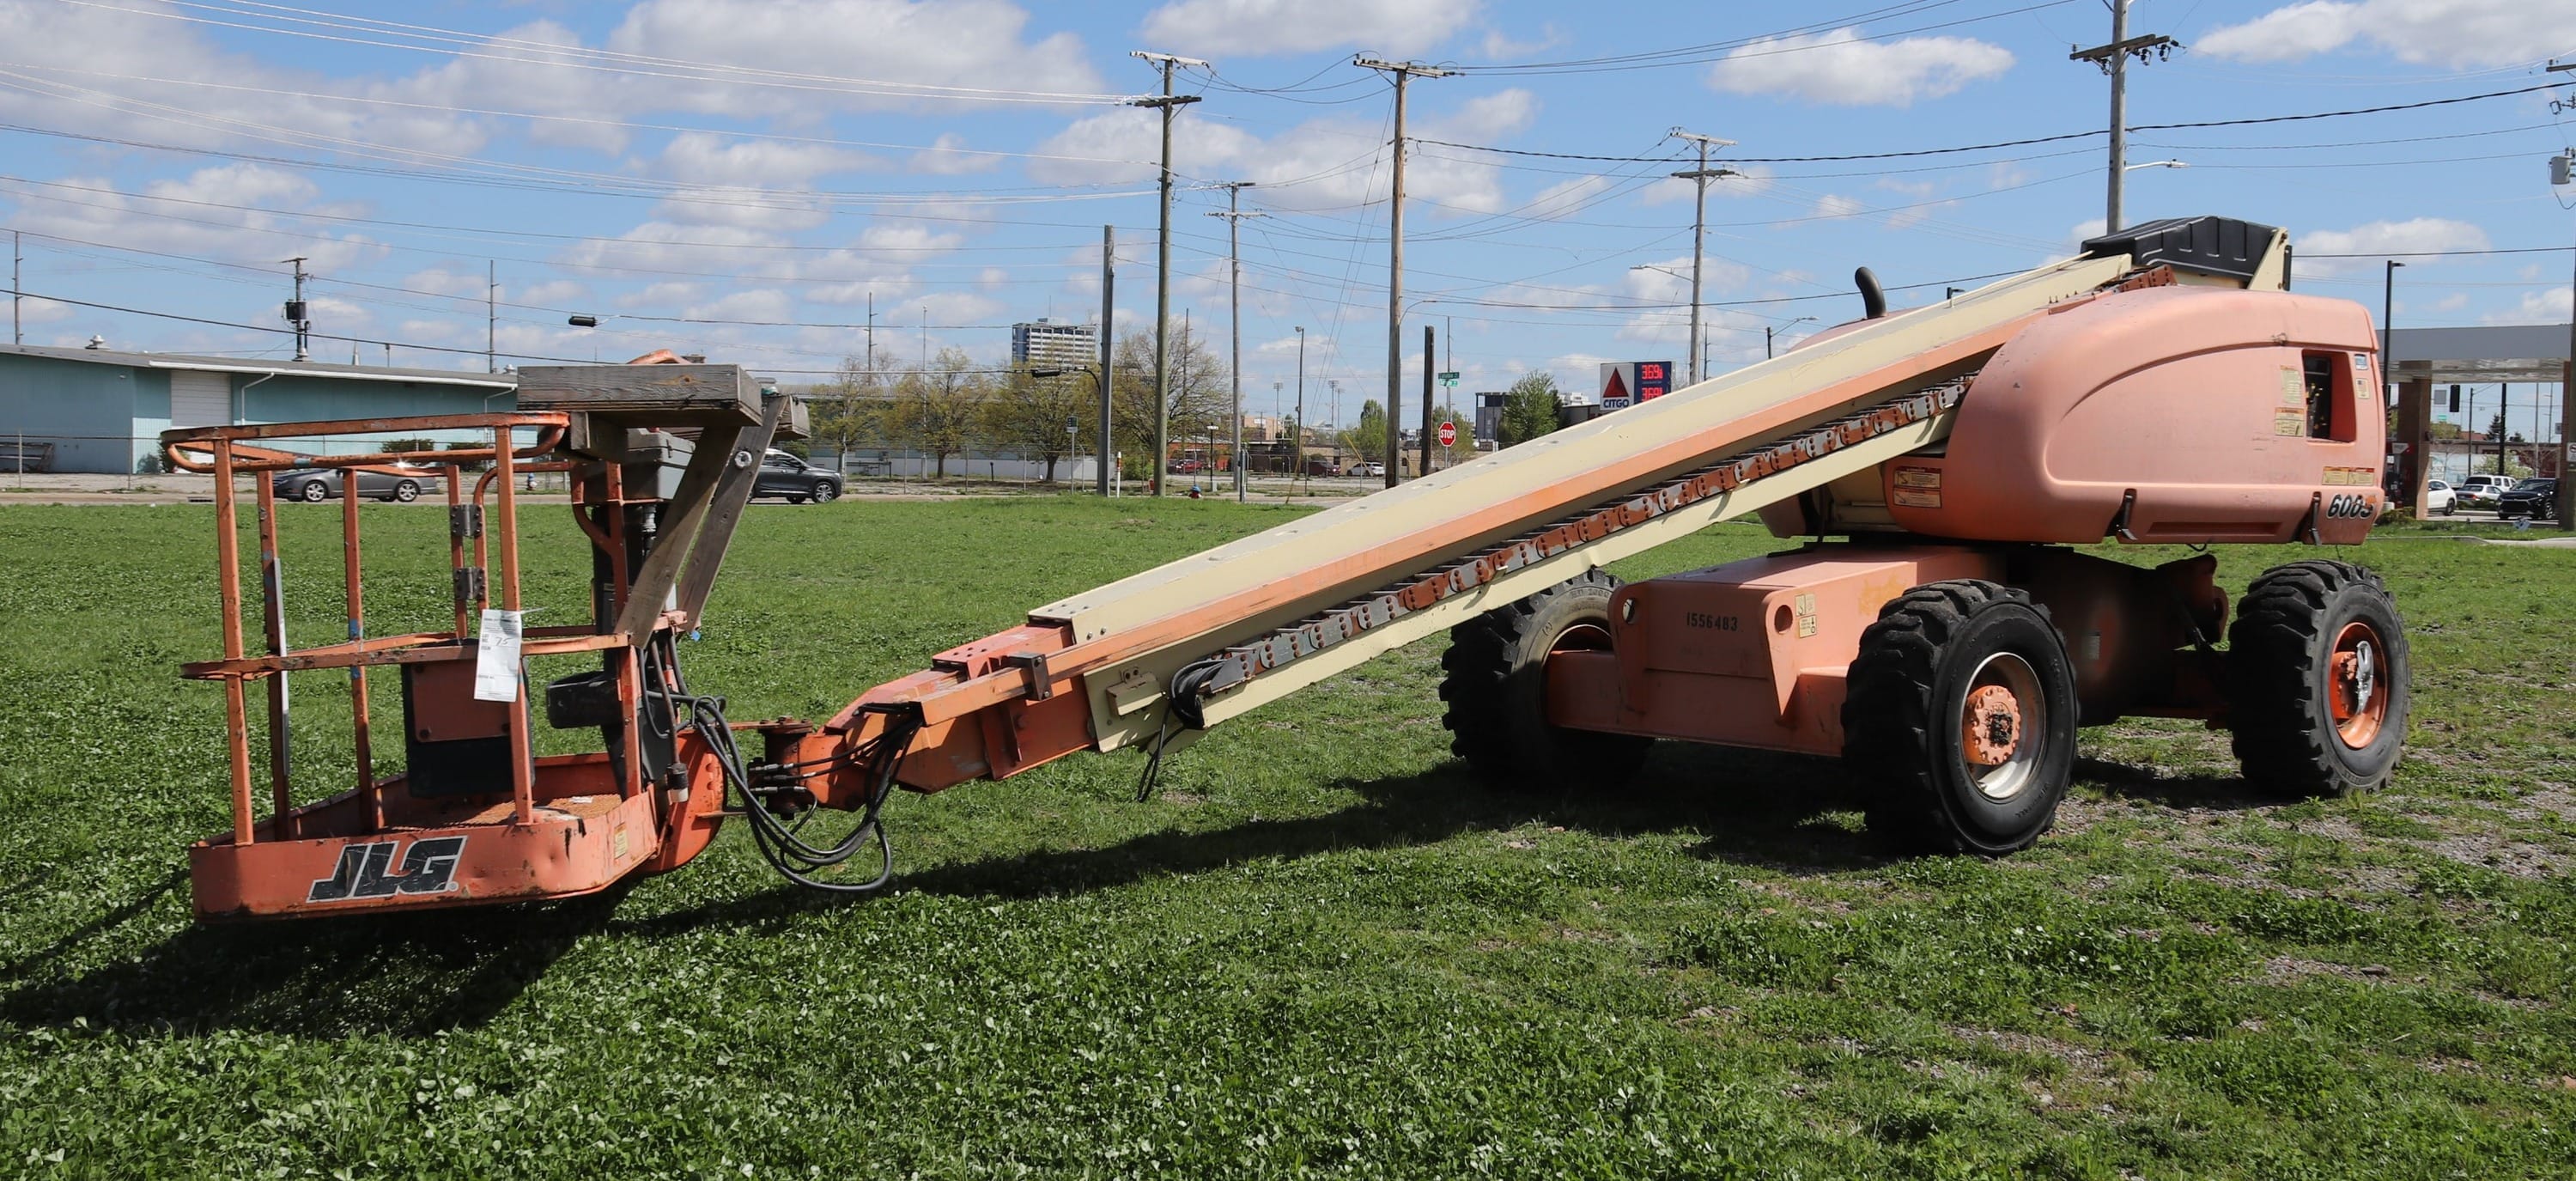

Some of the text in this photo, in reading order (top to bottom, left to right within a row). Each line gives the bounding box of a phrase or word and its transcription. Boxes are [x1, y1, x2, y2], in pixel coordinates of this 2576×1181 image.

[1603, 399, 1630, 409] CITGO
[1440, 429, 1455, 439] STOP
[1686, 612, 1739, 632] 1556483
[495, 636, 513, 647] 75
[306, 835, 468, 903] JLG
